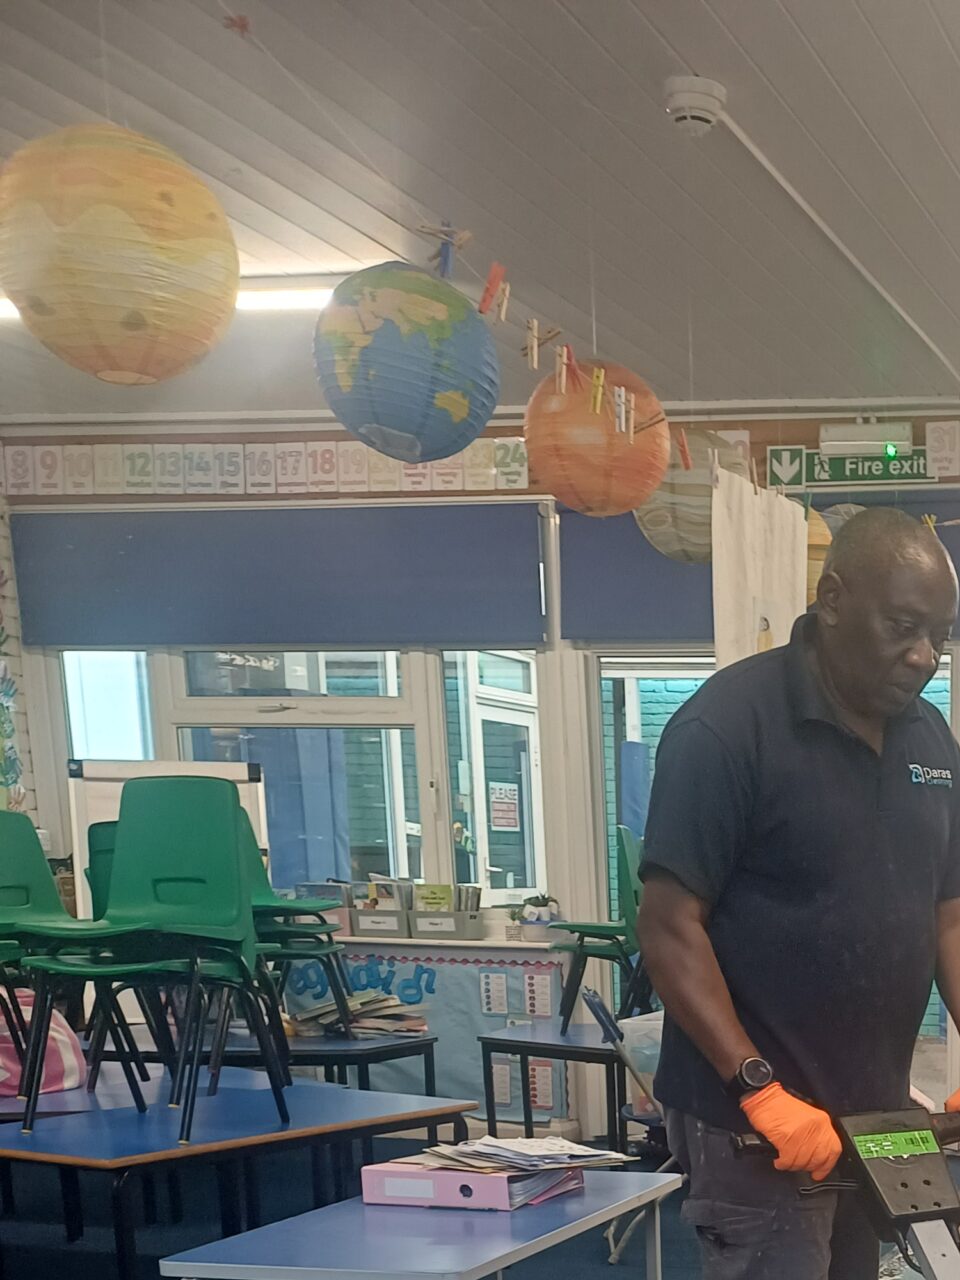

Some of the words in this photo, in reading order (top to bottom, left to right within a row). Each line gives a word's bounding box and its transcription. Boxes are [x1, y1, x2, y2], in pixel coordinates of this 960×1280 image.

[11, 450, 30, 480] 8
[39, 450, 58, 480] 9
[64, 451, 91, 478] 10
[125, 451, 152, 478] 12
[155, 451, 182, 477] 13
[183, 451, 212, 477] 14
[214, 451, 241, 477] 15
[244, 450, 273, 477] 16
[275, 449, 304, 476] 17
[307, 448, 336, 474] 18
[338, 448, 366, 474] 19
[495, 442, 527, 468] 24
[845, 457, 884, 476] Fire
[888, 457, 926, 476] exit
